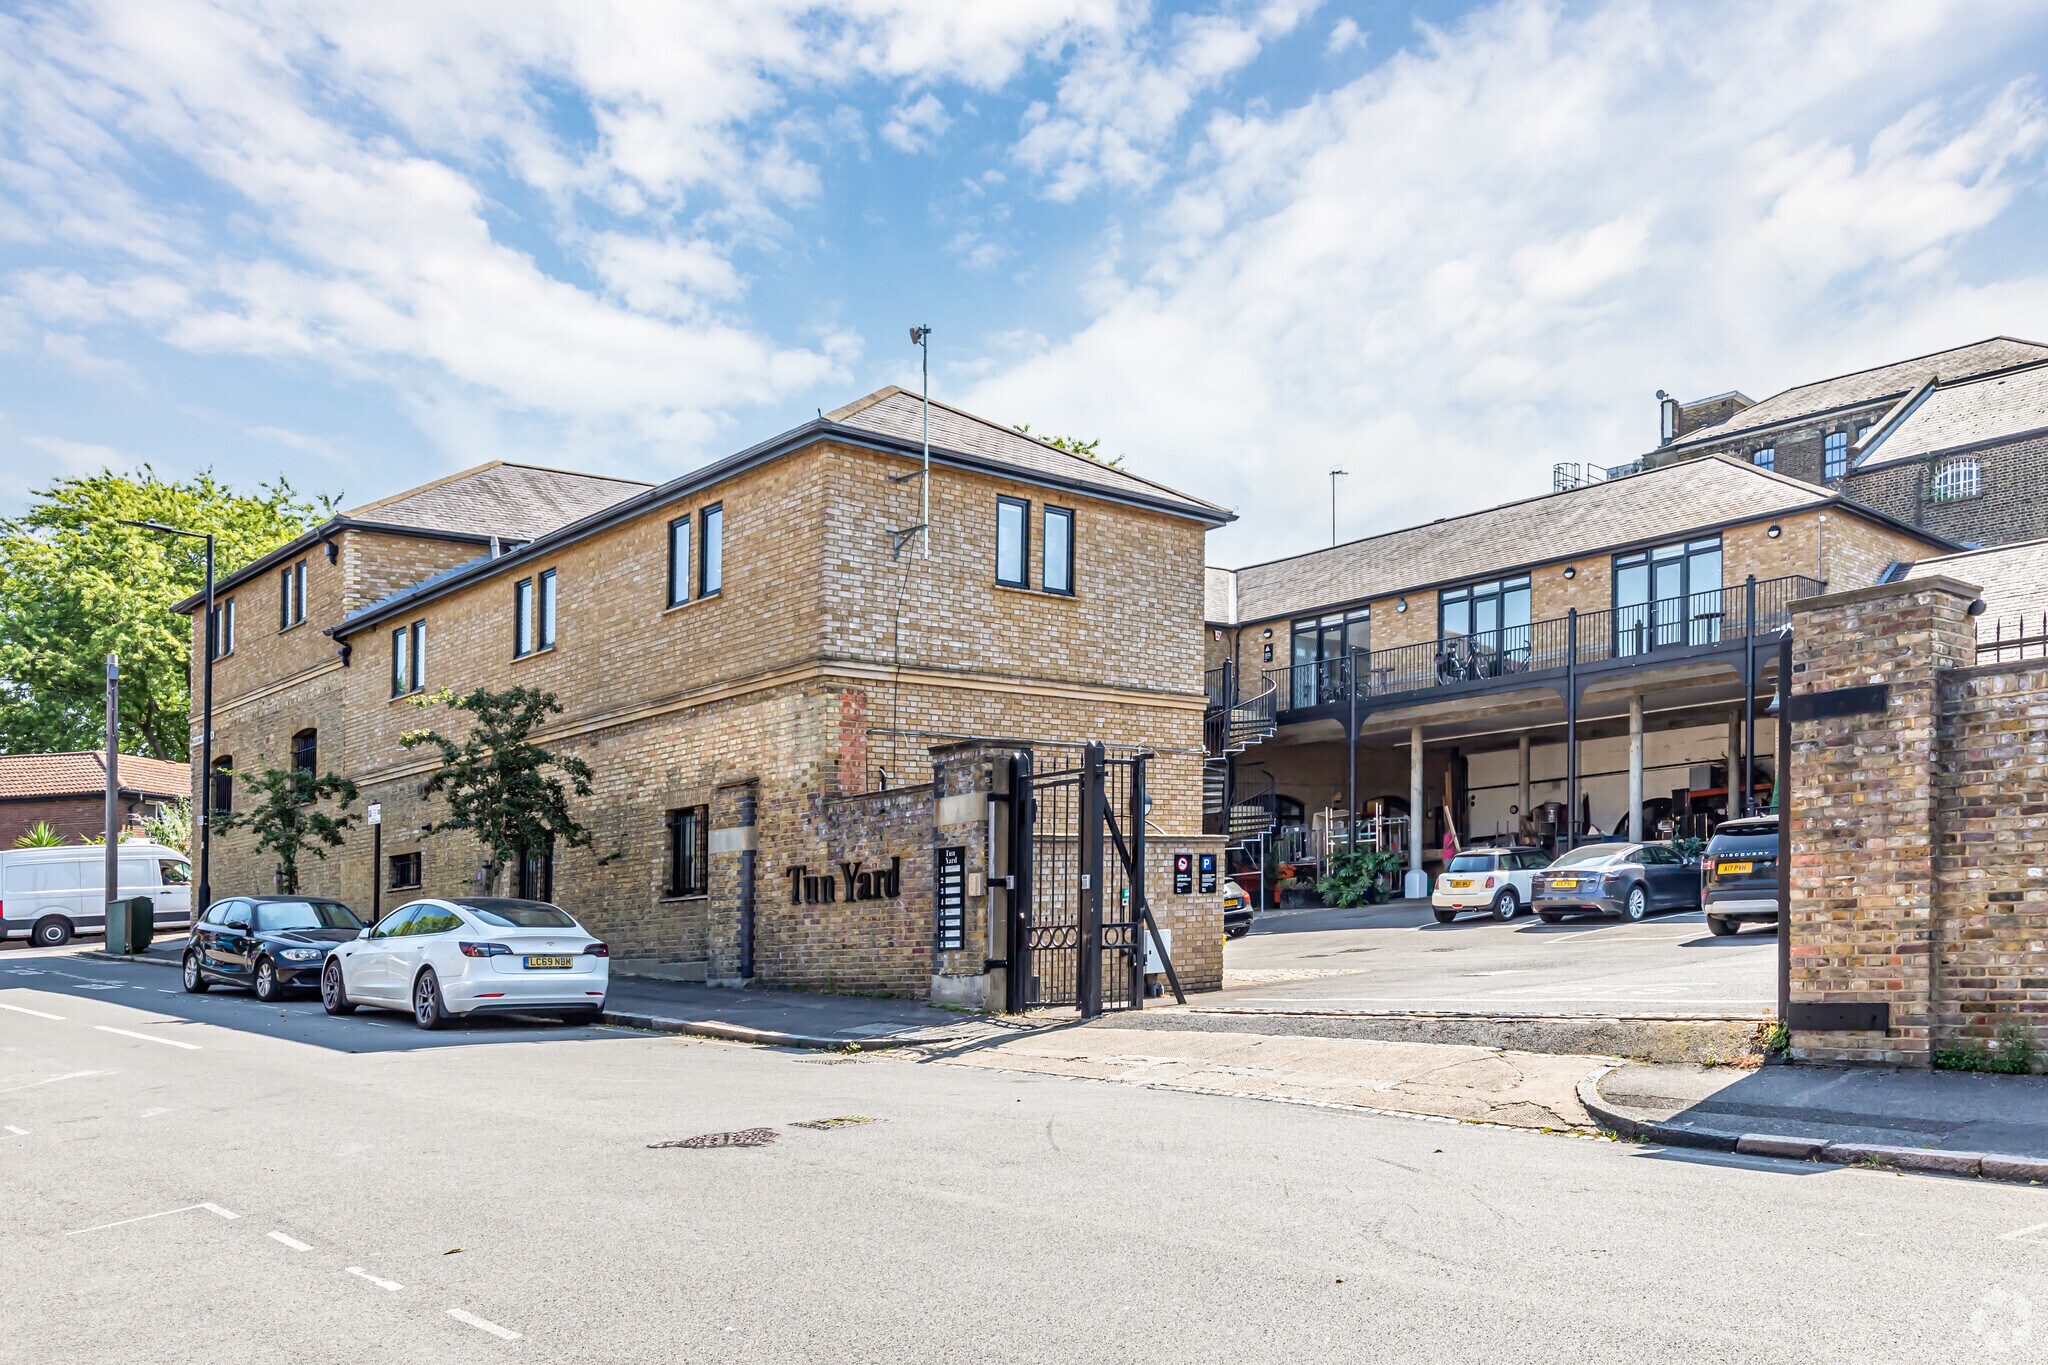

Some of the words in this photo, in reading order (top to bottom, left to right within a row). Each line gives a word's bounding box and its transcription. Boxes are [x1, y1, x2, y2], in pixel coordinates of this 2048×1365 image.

[1204, 858, 1210, 868] P
[786, 865, 836, 905] Tun
[839, 856, 901, 903] Yard
[530, 958, 552, 966] LC69
[555, 958, 571, 966] NBM
